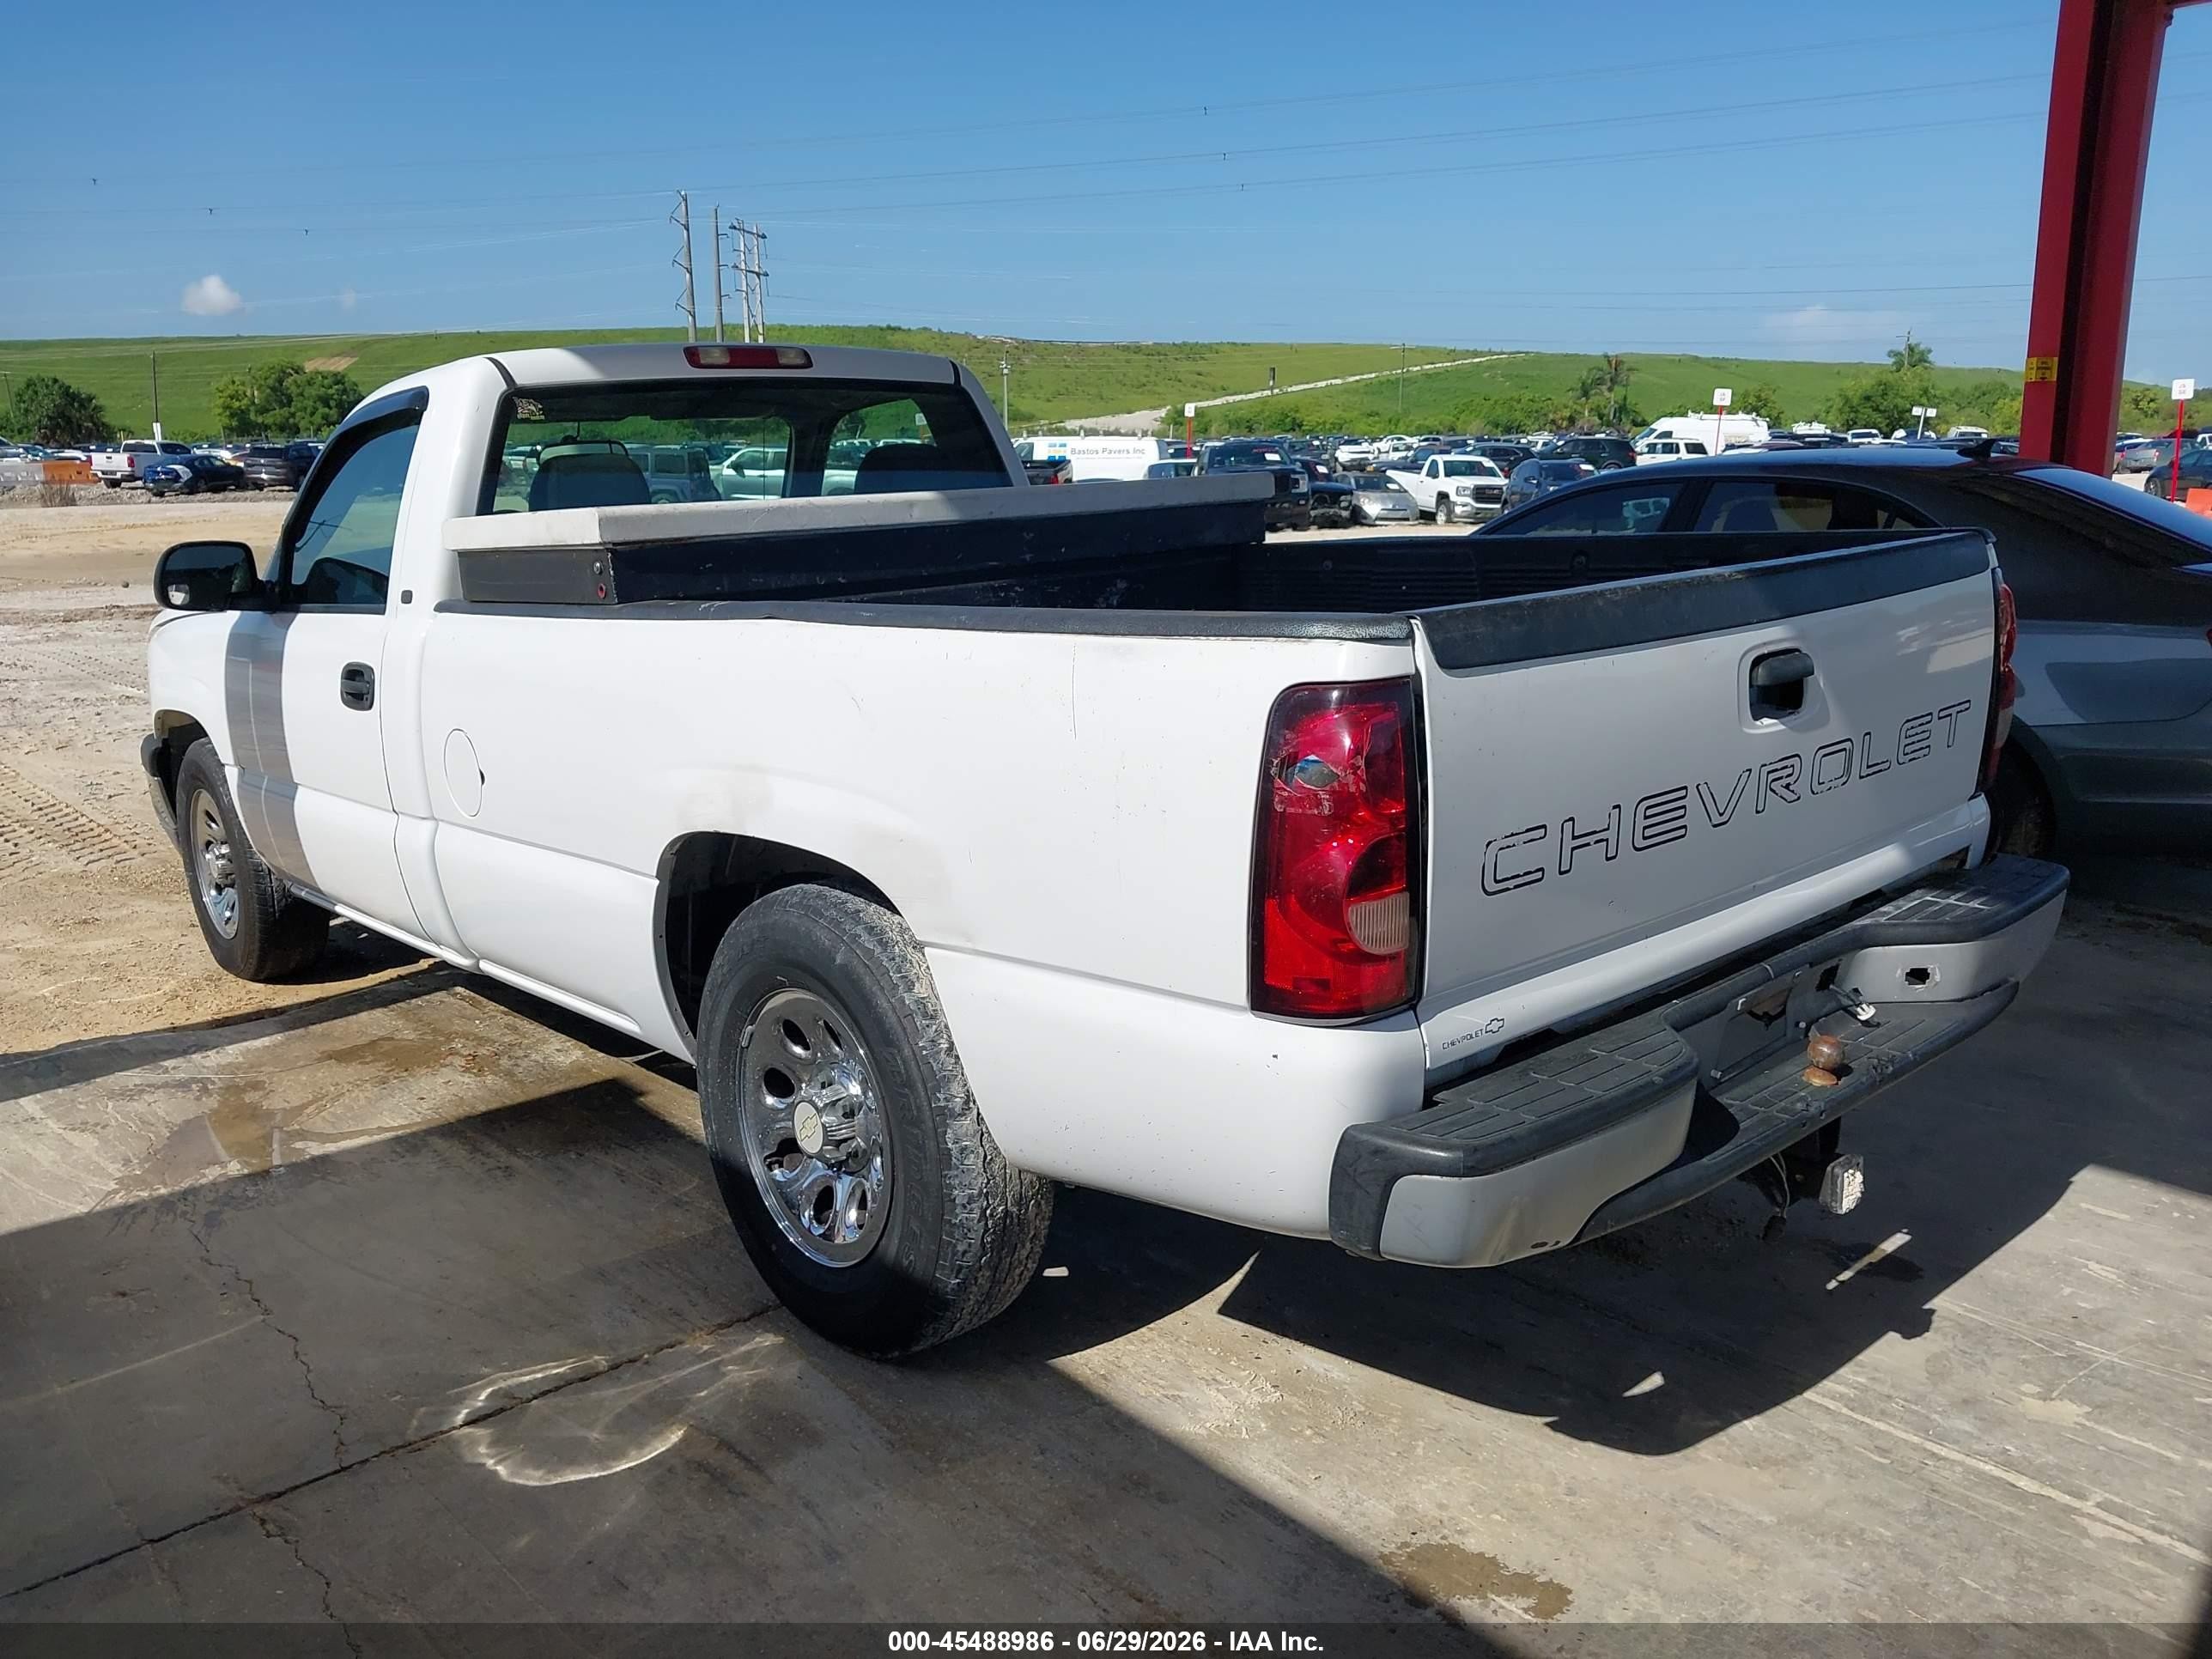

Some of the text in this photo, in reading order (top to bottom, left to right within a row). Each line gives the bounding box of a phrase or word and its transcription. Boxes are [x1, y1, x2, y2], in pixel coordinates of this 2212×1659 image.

[1071, 447, 1100, 455] Bastos
[1102, 447, 1131, 455] Pavers
[1481, 700, 1971, 896] CHEVROLET
[1442, 1028, 1485, 1050] CHEVROLET
